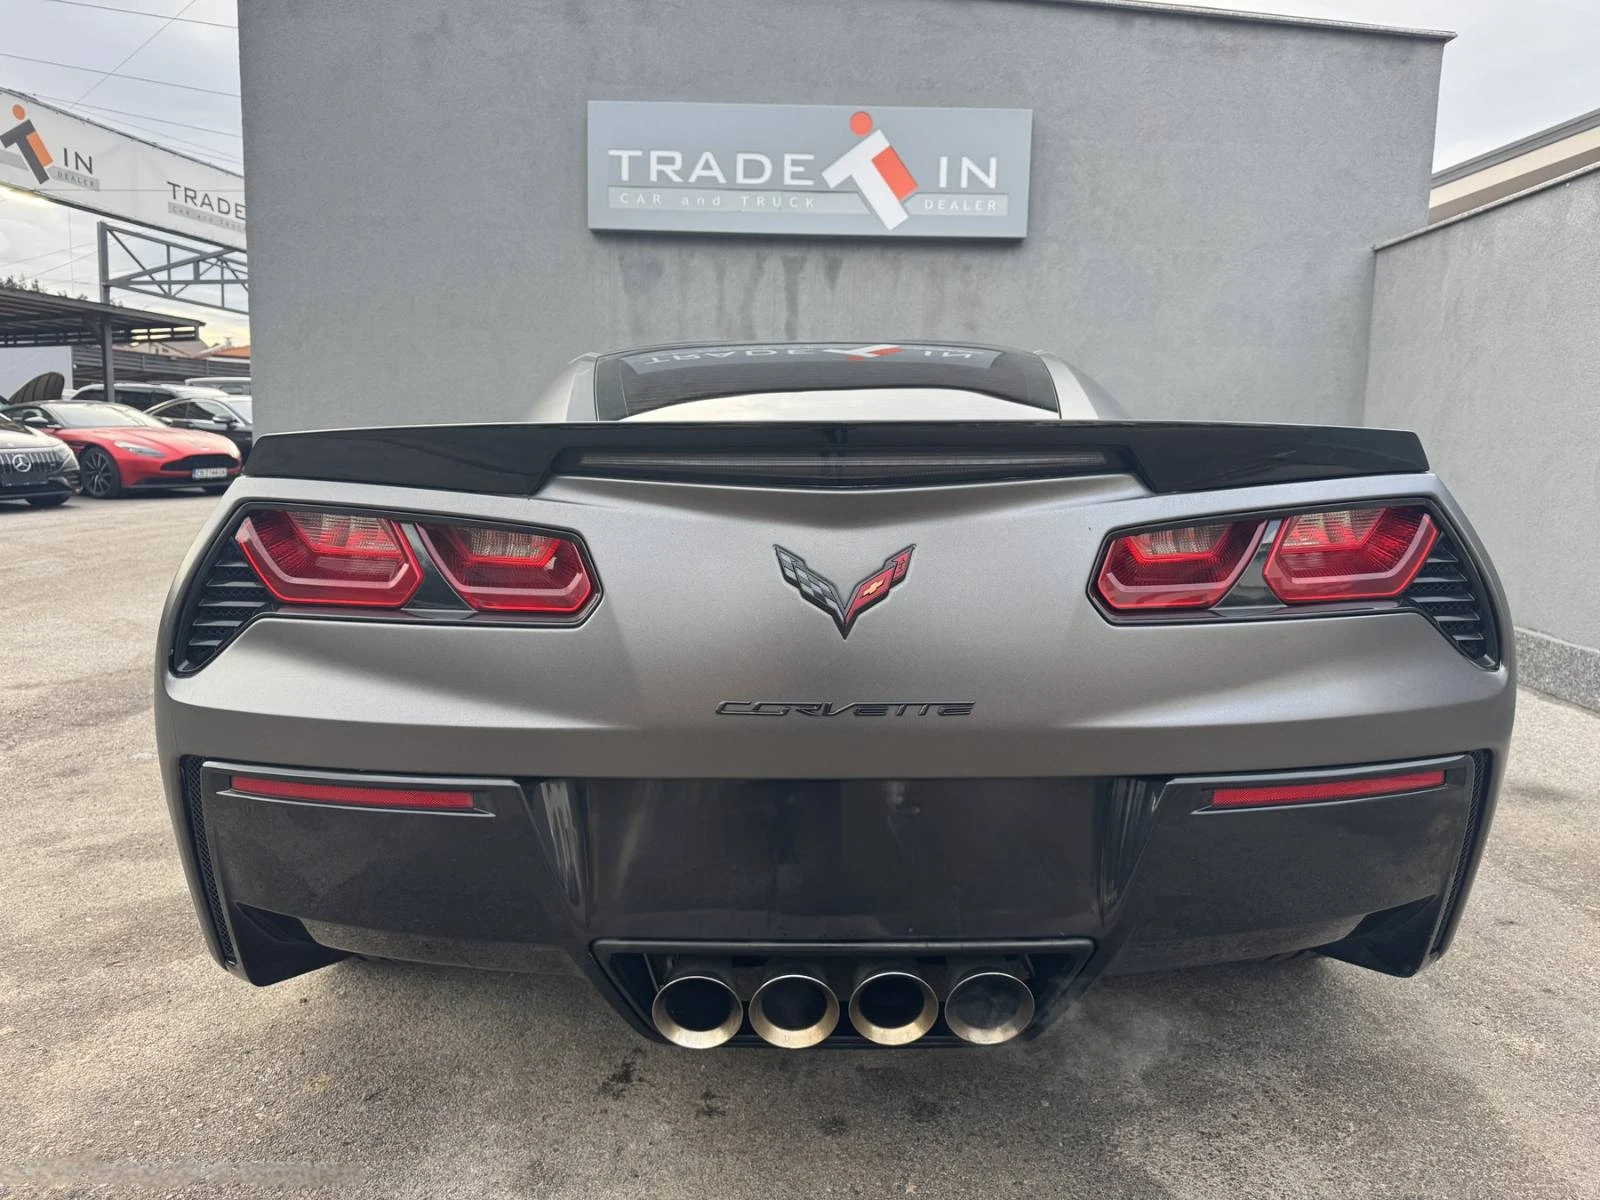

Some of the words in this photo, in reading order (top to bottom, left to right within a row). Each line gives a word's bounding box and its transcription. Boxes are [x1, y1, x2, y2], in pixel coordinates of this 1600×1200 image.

[63, 147, 93, 175] IN
[607, 150, 815, 186] TRADE
[938, 156, 997, 189] IN
[167, 181, 247, 220] TRADE
[619, 193, 663, 206] CAR
[681, 195, 721, 207] and
[741, 196, 816, 209] TRUCK
[924, 199, 998, 211] DEALER
[715, 701, 976, 717] CORVETTE
